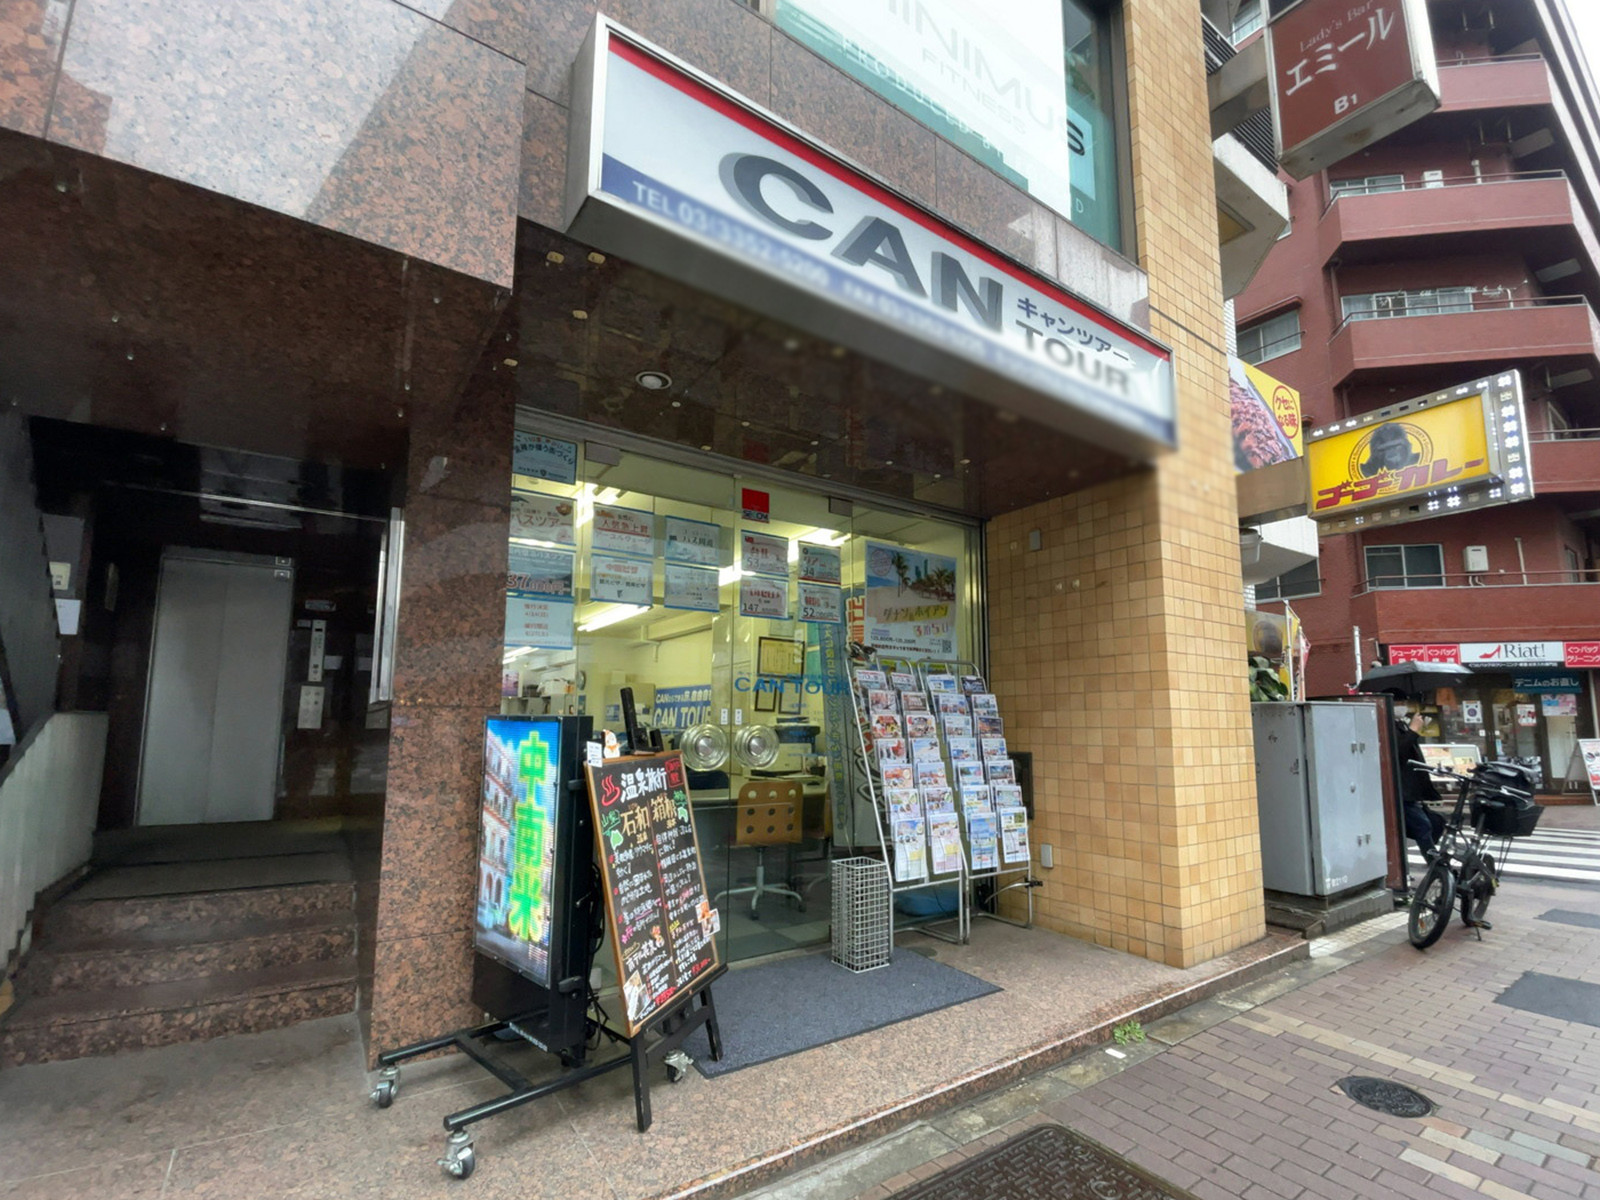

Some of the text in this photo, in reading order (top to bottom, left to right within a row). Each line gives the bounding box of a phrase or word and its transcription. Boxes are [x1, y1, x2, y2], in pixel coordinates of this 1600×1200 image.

[1286, 8, 1394, 96] エミール
[1300, 19, 1342, 52] Lady's
[922, 47, 1027, 135] FITNESS
[1334, 93, 1358, 114] B1
[632, 180, 676, 217] TEL
[718, 151, 1003, 336] CAN
[1016, 297, 1130, 362] キャンツアー
[1015, 318, 1131, 395] TOUR
[1504, 643, 1546, 659] Riat!
[734, 676, 850, 696] CAN TOUR
[1514, 677, 1580, 688] デニムのお直し
[620, 767, 668, 804] 温泉旅行
[509, 731, 549, 942] 中南米
